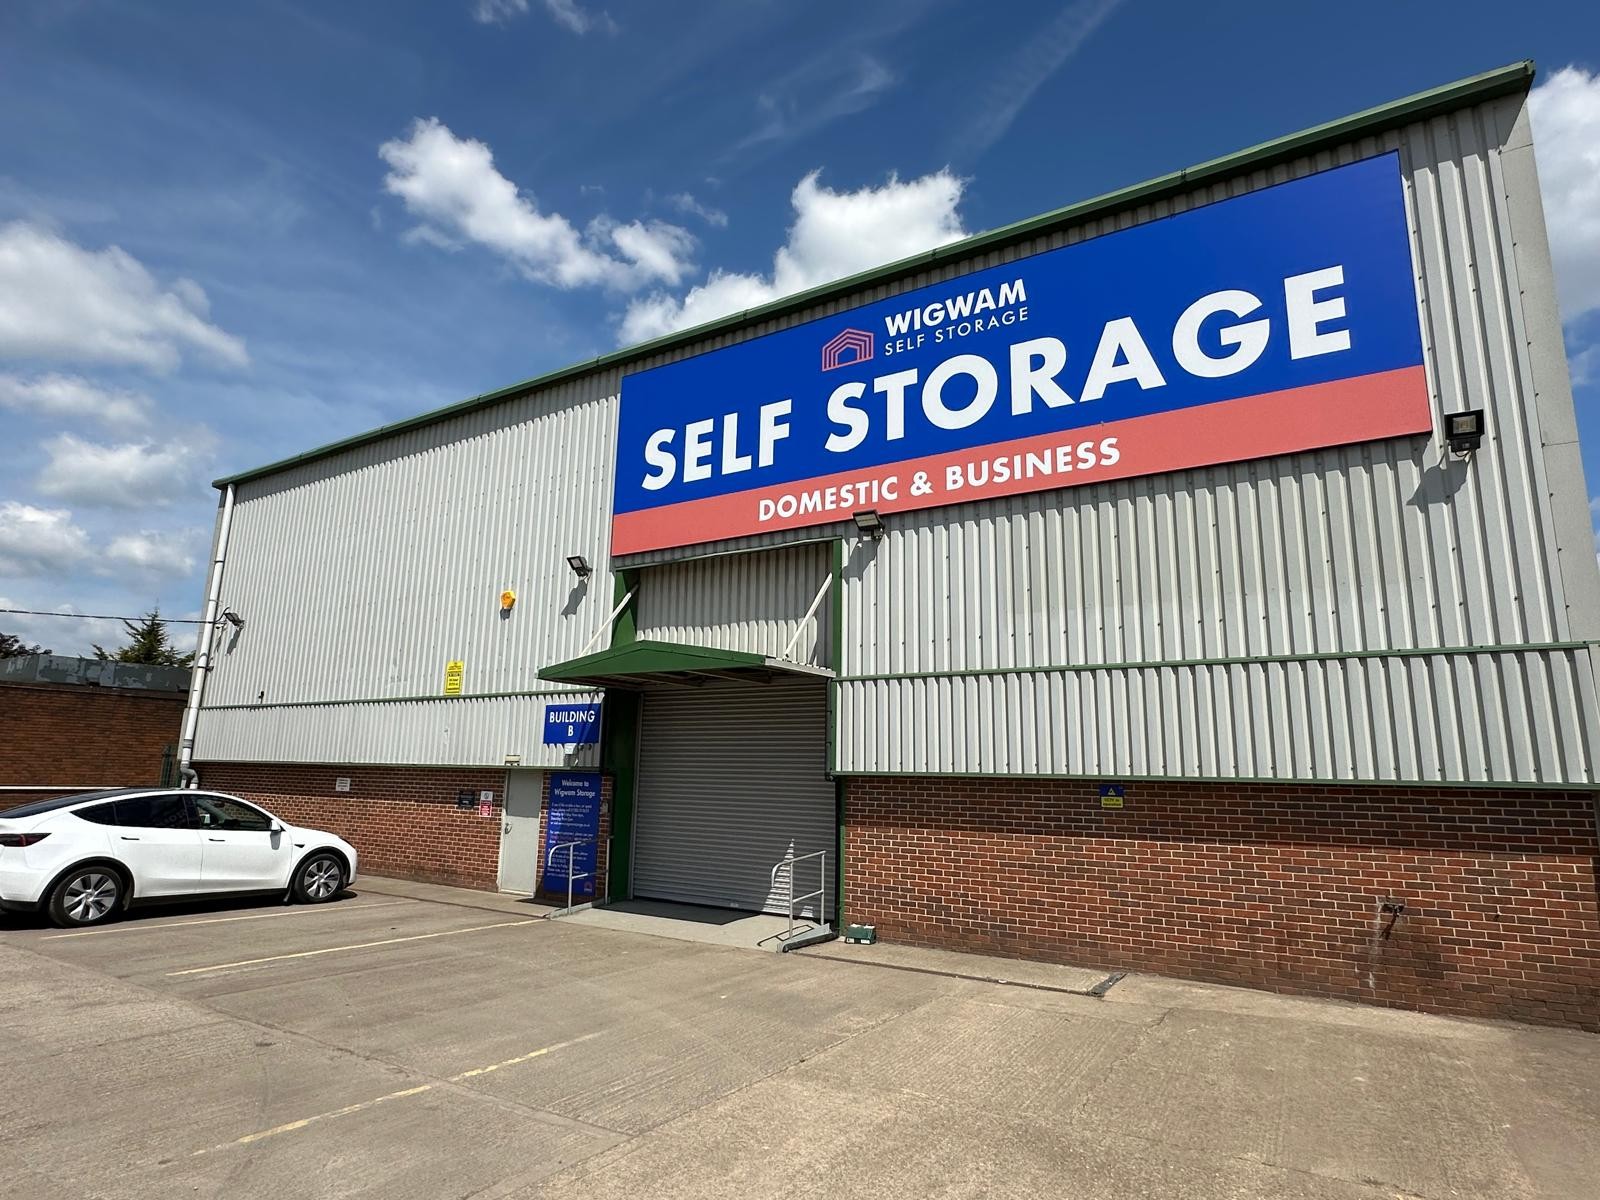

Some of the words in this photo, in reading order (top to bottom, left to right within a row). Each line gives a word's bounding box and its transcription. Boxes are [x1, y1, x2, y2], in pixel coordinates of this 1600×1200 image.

[885, 279, 1027, 337] WIGWAM
[884, 334, 925, 356] SELF
[935, 306, 1028, 343] STORAGE
[641, 399, 792, 490] SELF
[824, 265, 1351, 453] STORAGE
[758, 476, 898, 522] DOMESTIC
[910, 471, 934, 497] &
[945, 437, 1120, 491] BUSINESS
[549, 711, 596, 723] BUILDING
[567, 725, 574, 737] B
[554, 788, 576, 797] Wigwam
[576, 789, 596, 799] Storage
[562, 779, 583, 787] Welcome
